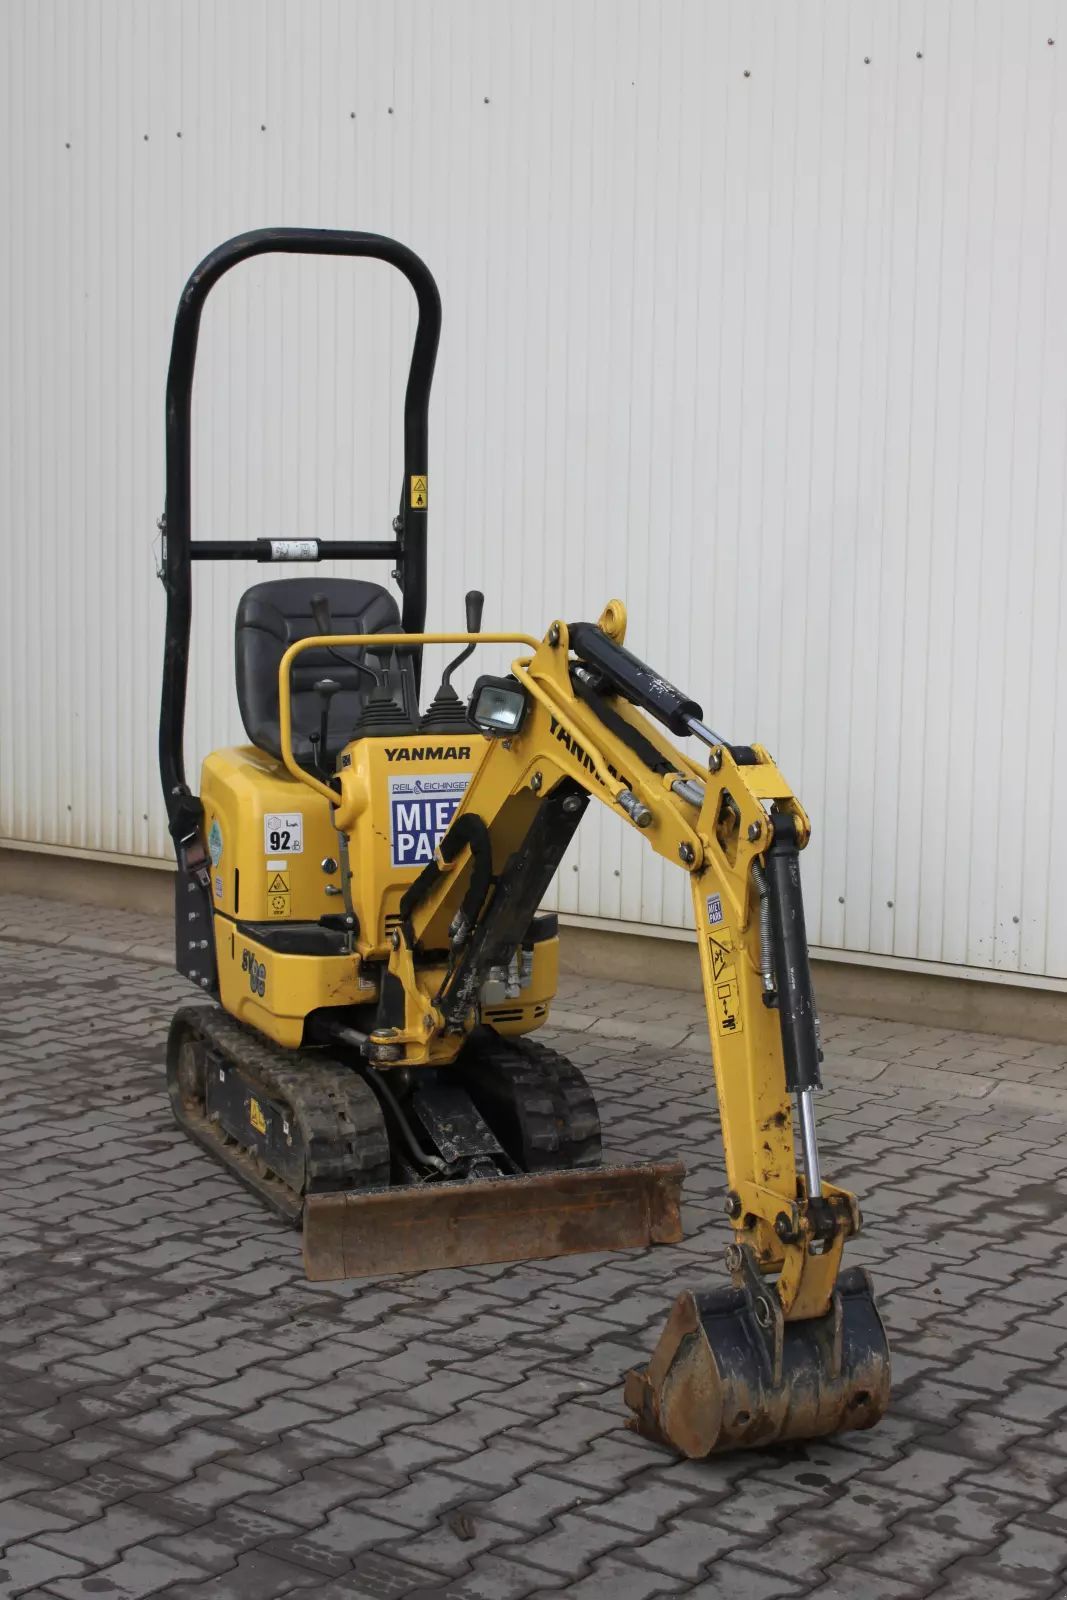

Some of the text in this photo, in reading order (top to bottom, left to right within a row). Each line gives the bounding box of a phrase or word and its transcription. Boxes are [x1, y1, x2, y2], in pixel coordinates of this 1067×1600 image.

[384, 747, 471, 762] YANMAR
[392, 783, 413, 791] REIL
[413, 780, 422, 794] &
[270, 831, 291, 851] 92
[397, 831, 445, 862] PA
